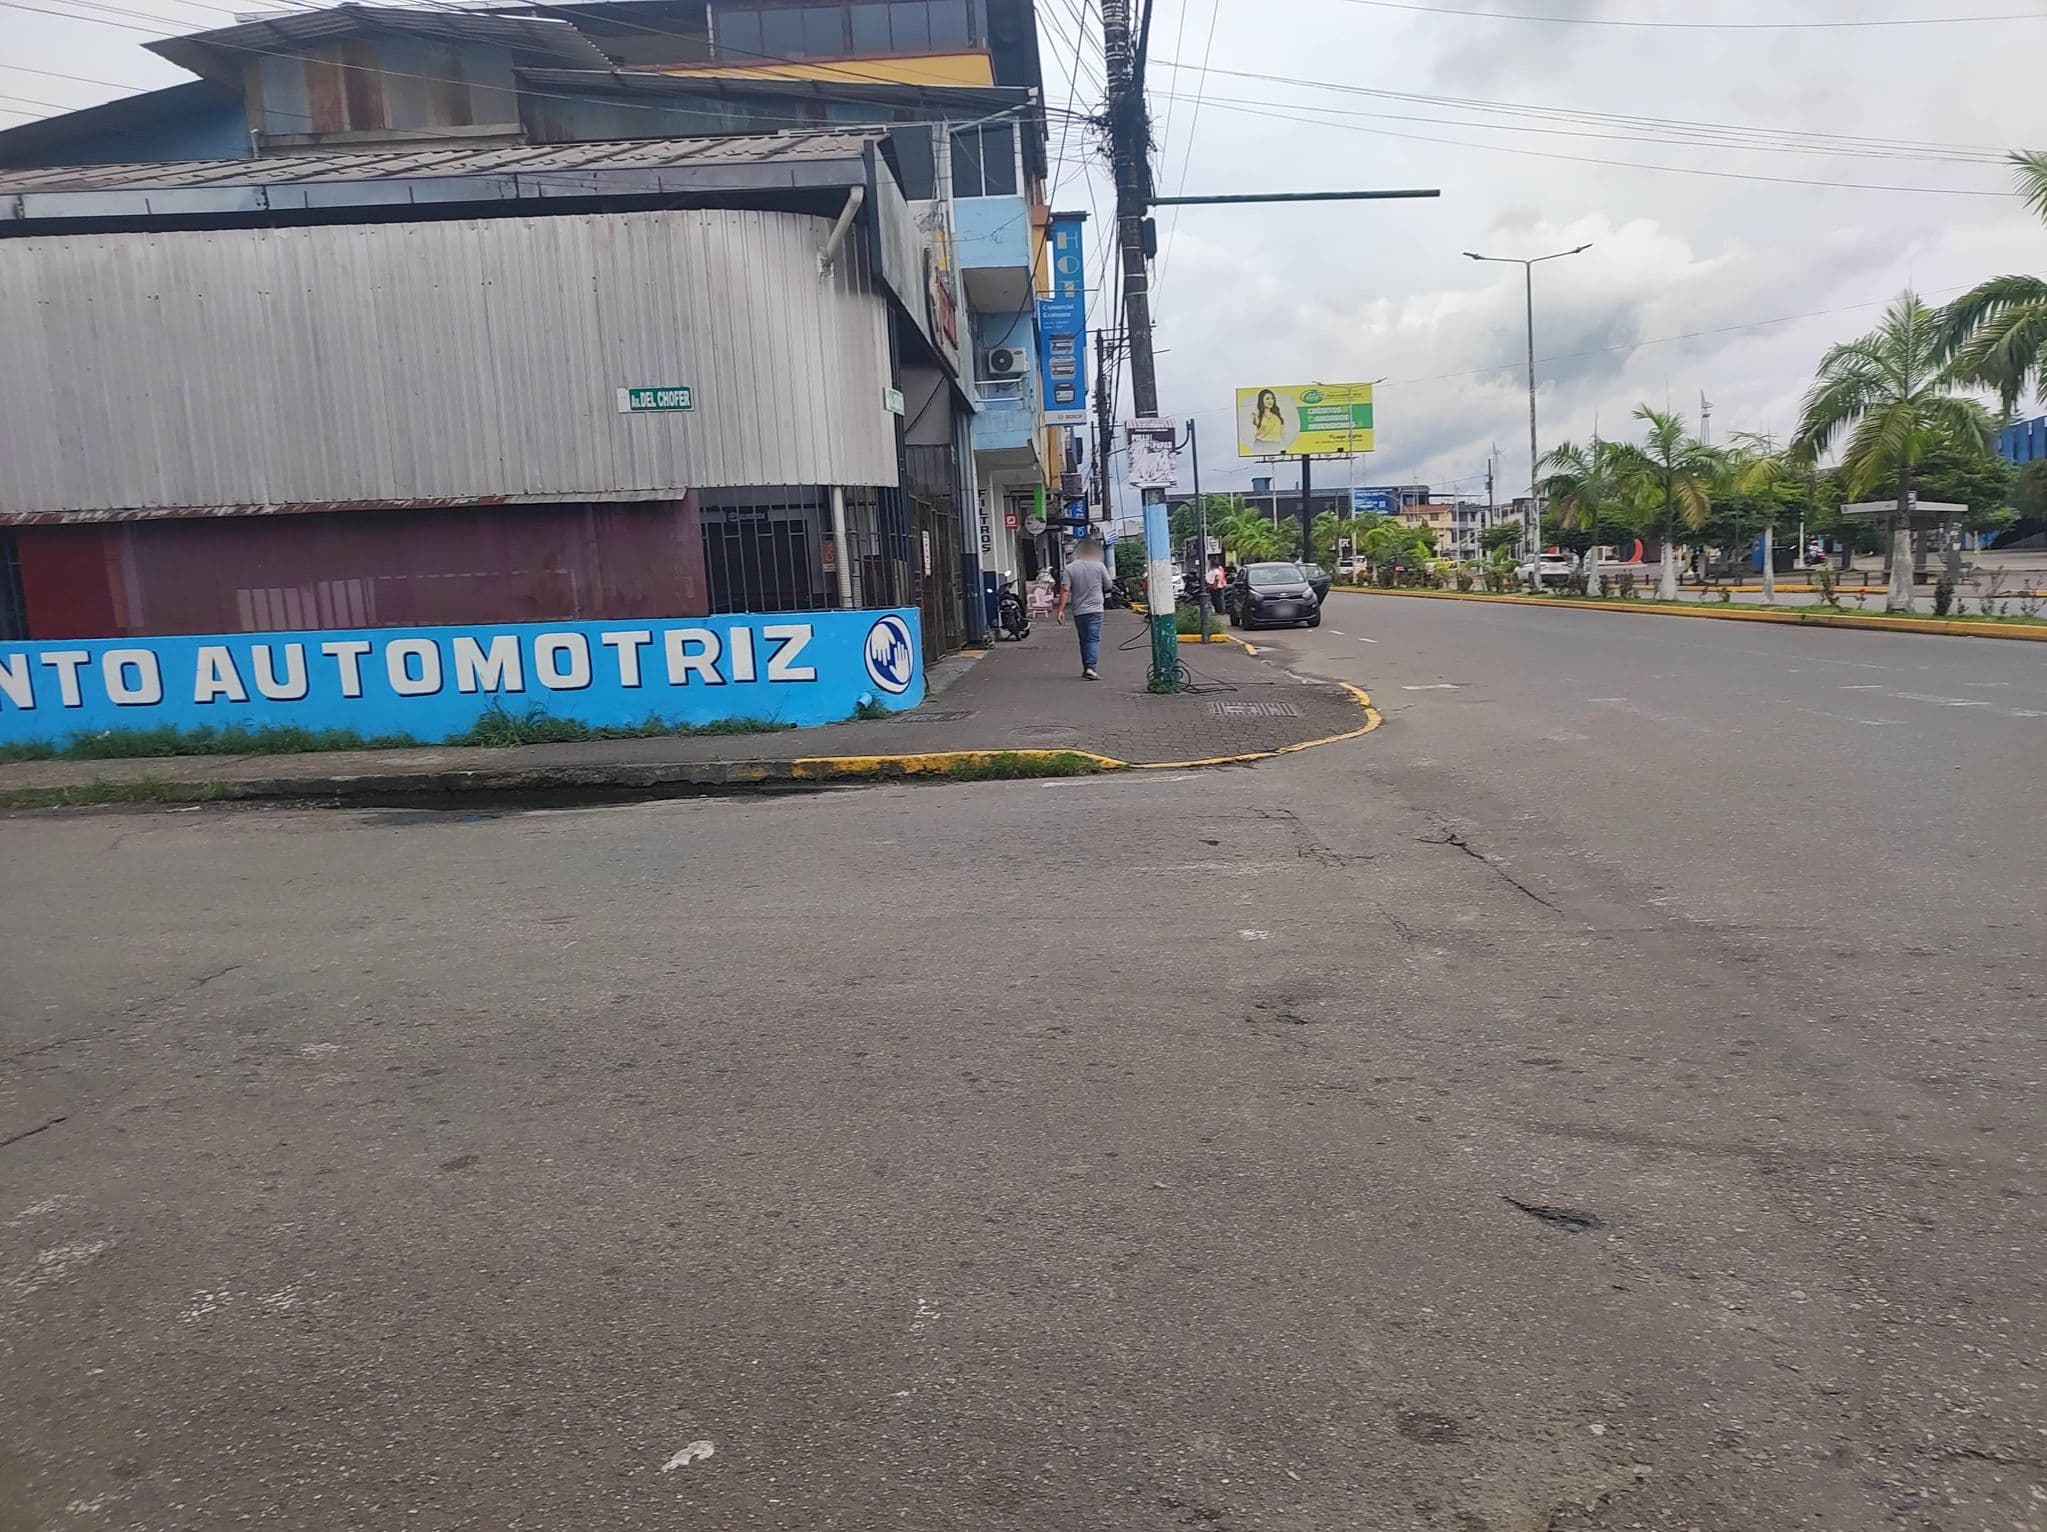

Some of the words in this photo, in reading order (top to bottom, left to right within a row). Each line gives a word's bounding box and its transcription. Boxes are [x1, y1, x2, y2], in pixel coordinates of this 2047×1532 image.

[640, 391, 657, 408] DEL
[657, 390, 691, 407] CHOFER
[978, 489, 991, 553] FILTROS
[194, 623, 818, 704] AUTOMOTRIZ
